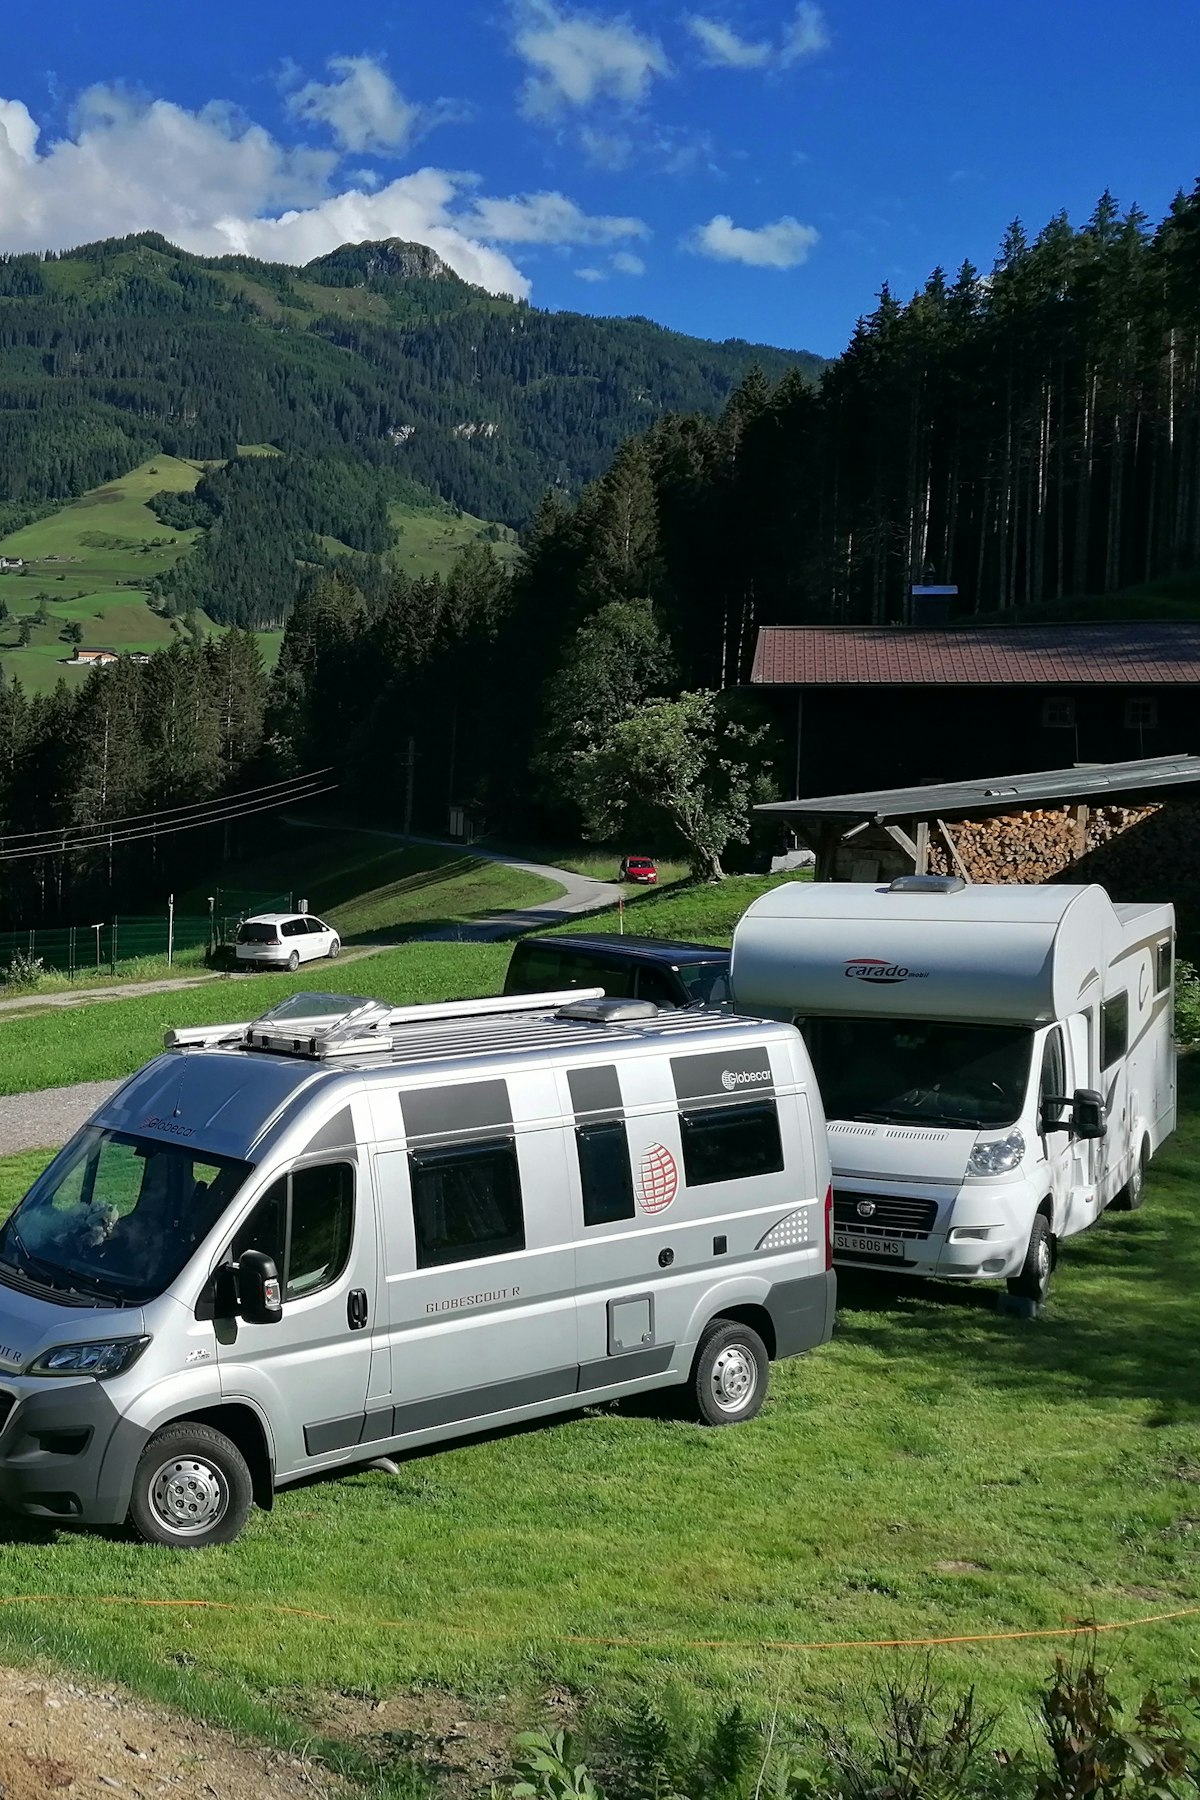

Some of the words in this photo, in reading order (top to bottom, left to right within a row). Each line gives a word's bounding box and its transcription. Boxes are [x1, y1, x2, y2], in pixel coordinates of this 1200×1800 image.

[729, 1070, 771, 1084] Globecar
[148, 1118, 196, 1136] Globecar
[837, 1237, 850, 1248] SL
[883, 1241, 899, 1254] MS
[426, 1288, 509, 1313] GLOBESCOUT
[512, 1286, 520, 1296] R
[12, 1351, 22, 1362] R
